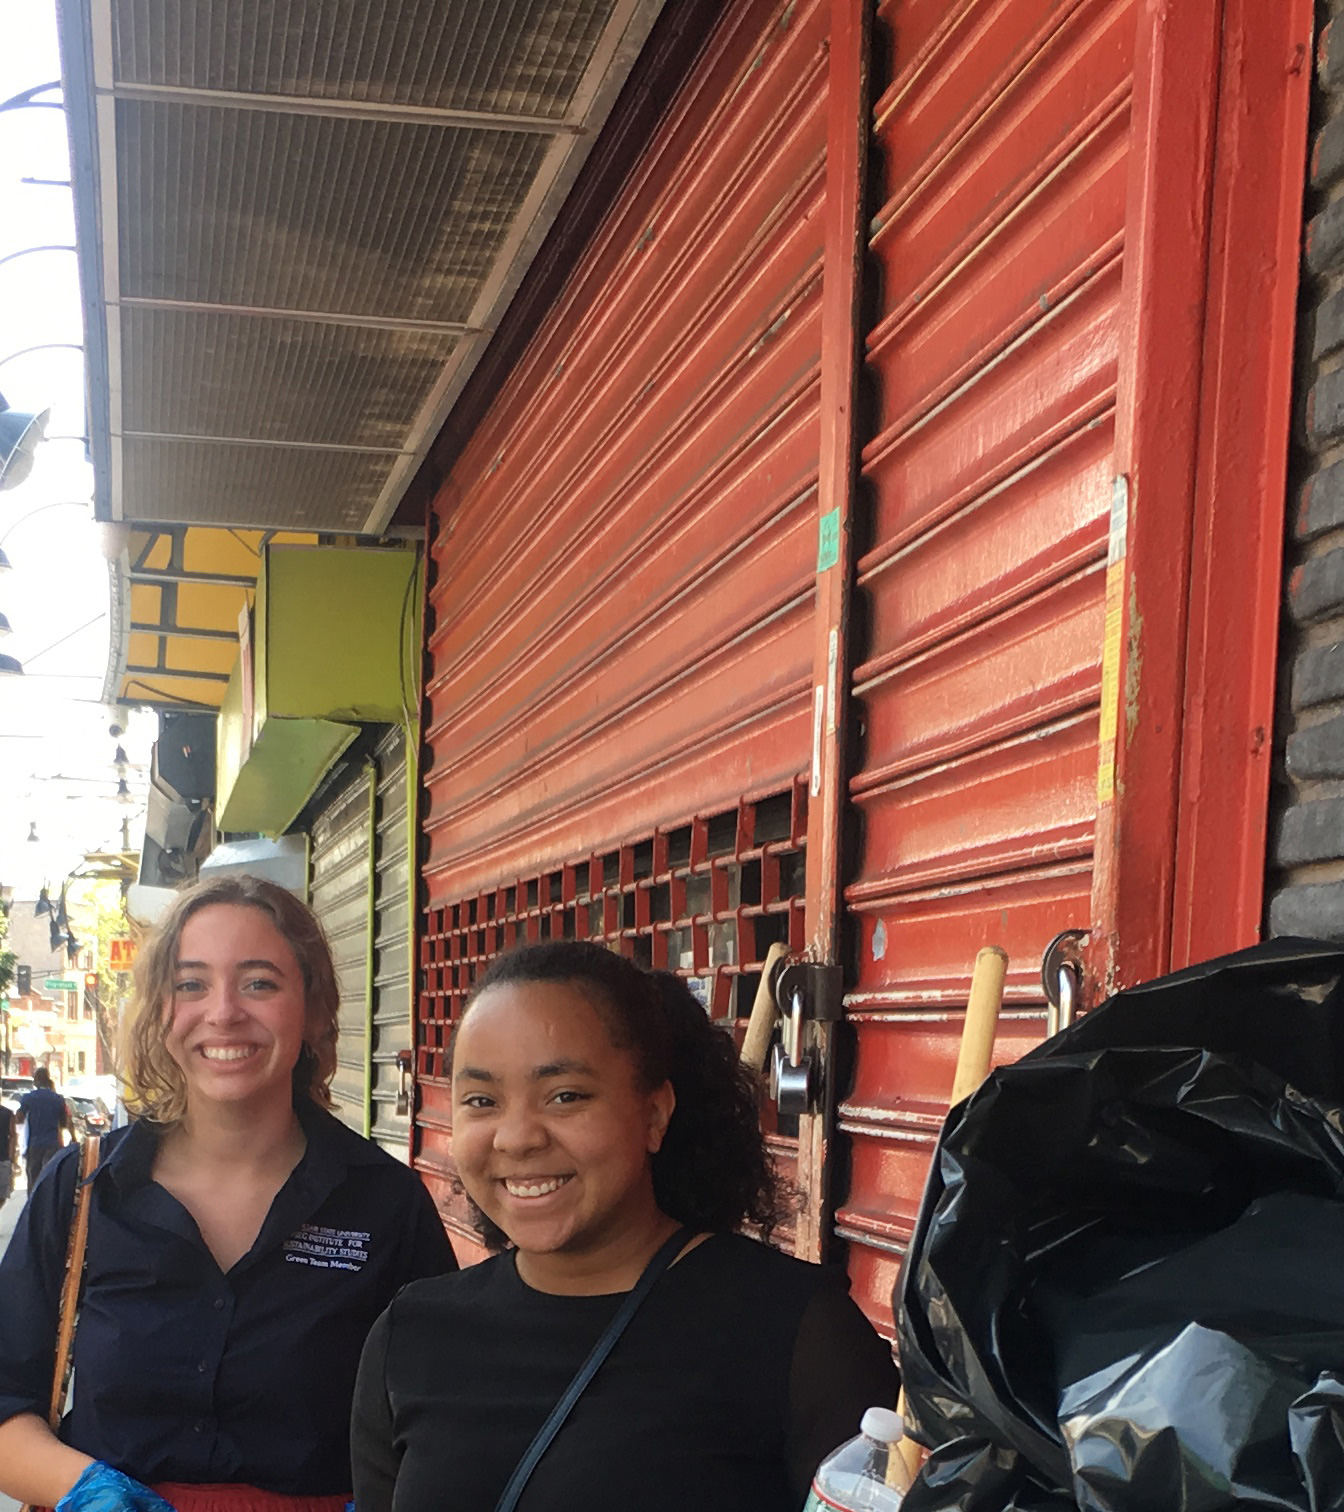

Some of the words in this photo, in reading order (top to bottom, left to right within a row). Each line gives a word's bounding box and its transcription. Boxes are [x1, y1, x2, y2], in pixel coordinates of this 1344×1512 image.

[111, 941, 136, 961] AT
[347, 1240, 363, 1248] FOR
[339, 1248, 369, 1259] STUDIES
[285, 1253, 309, 1264] Green
[309, 1257, 329, 1268] Team
[329, 1260, 362, 1272] Member
